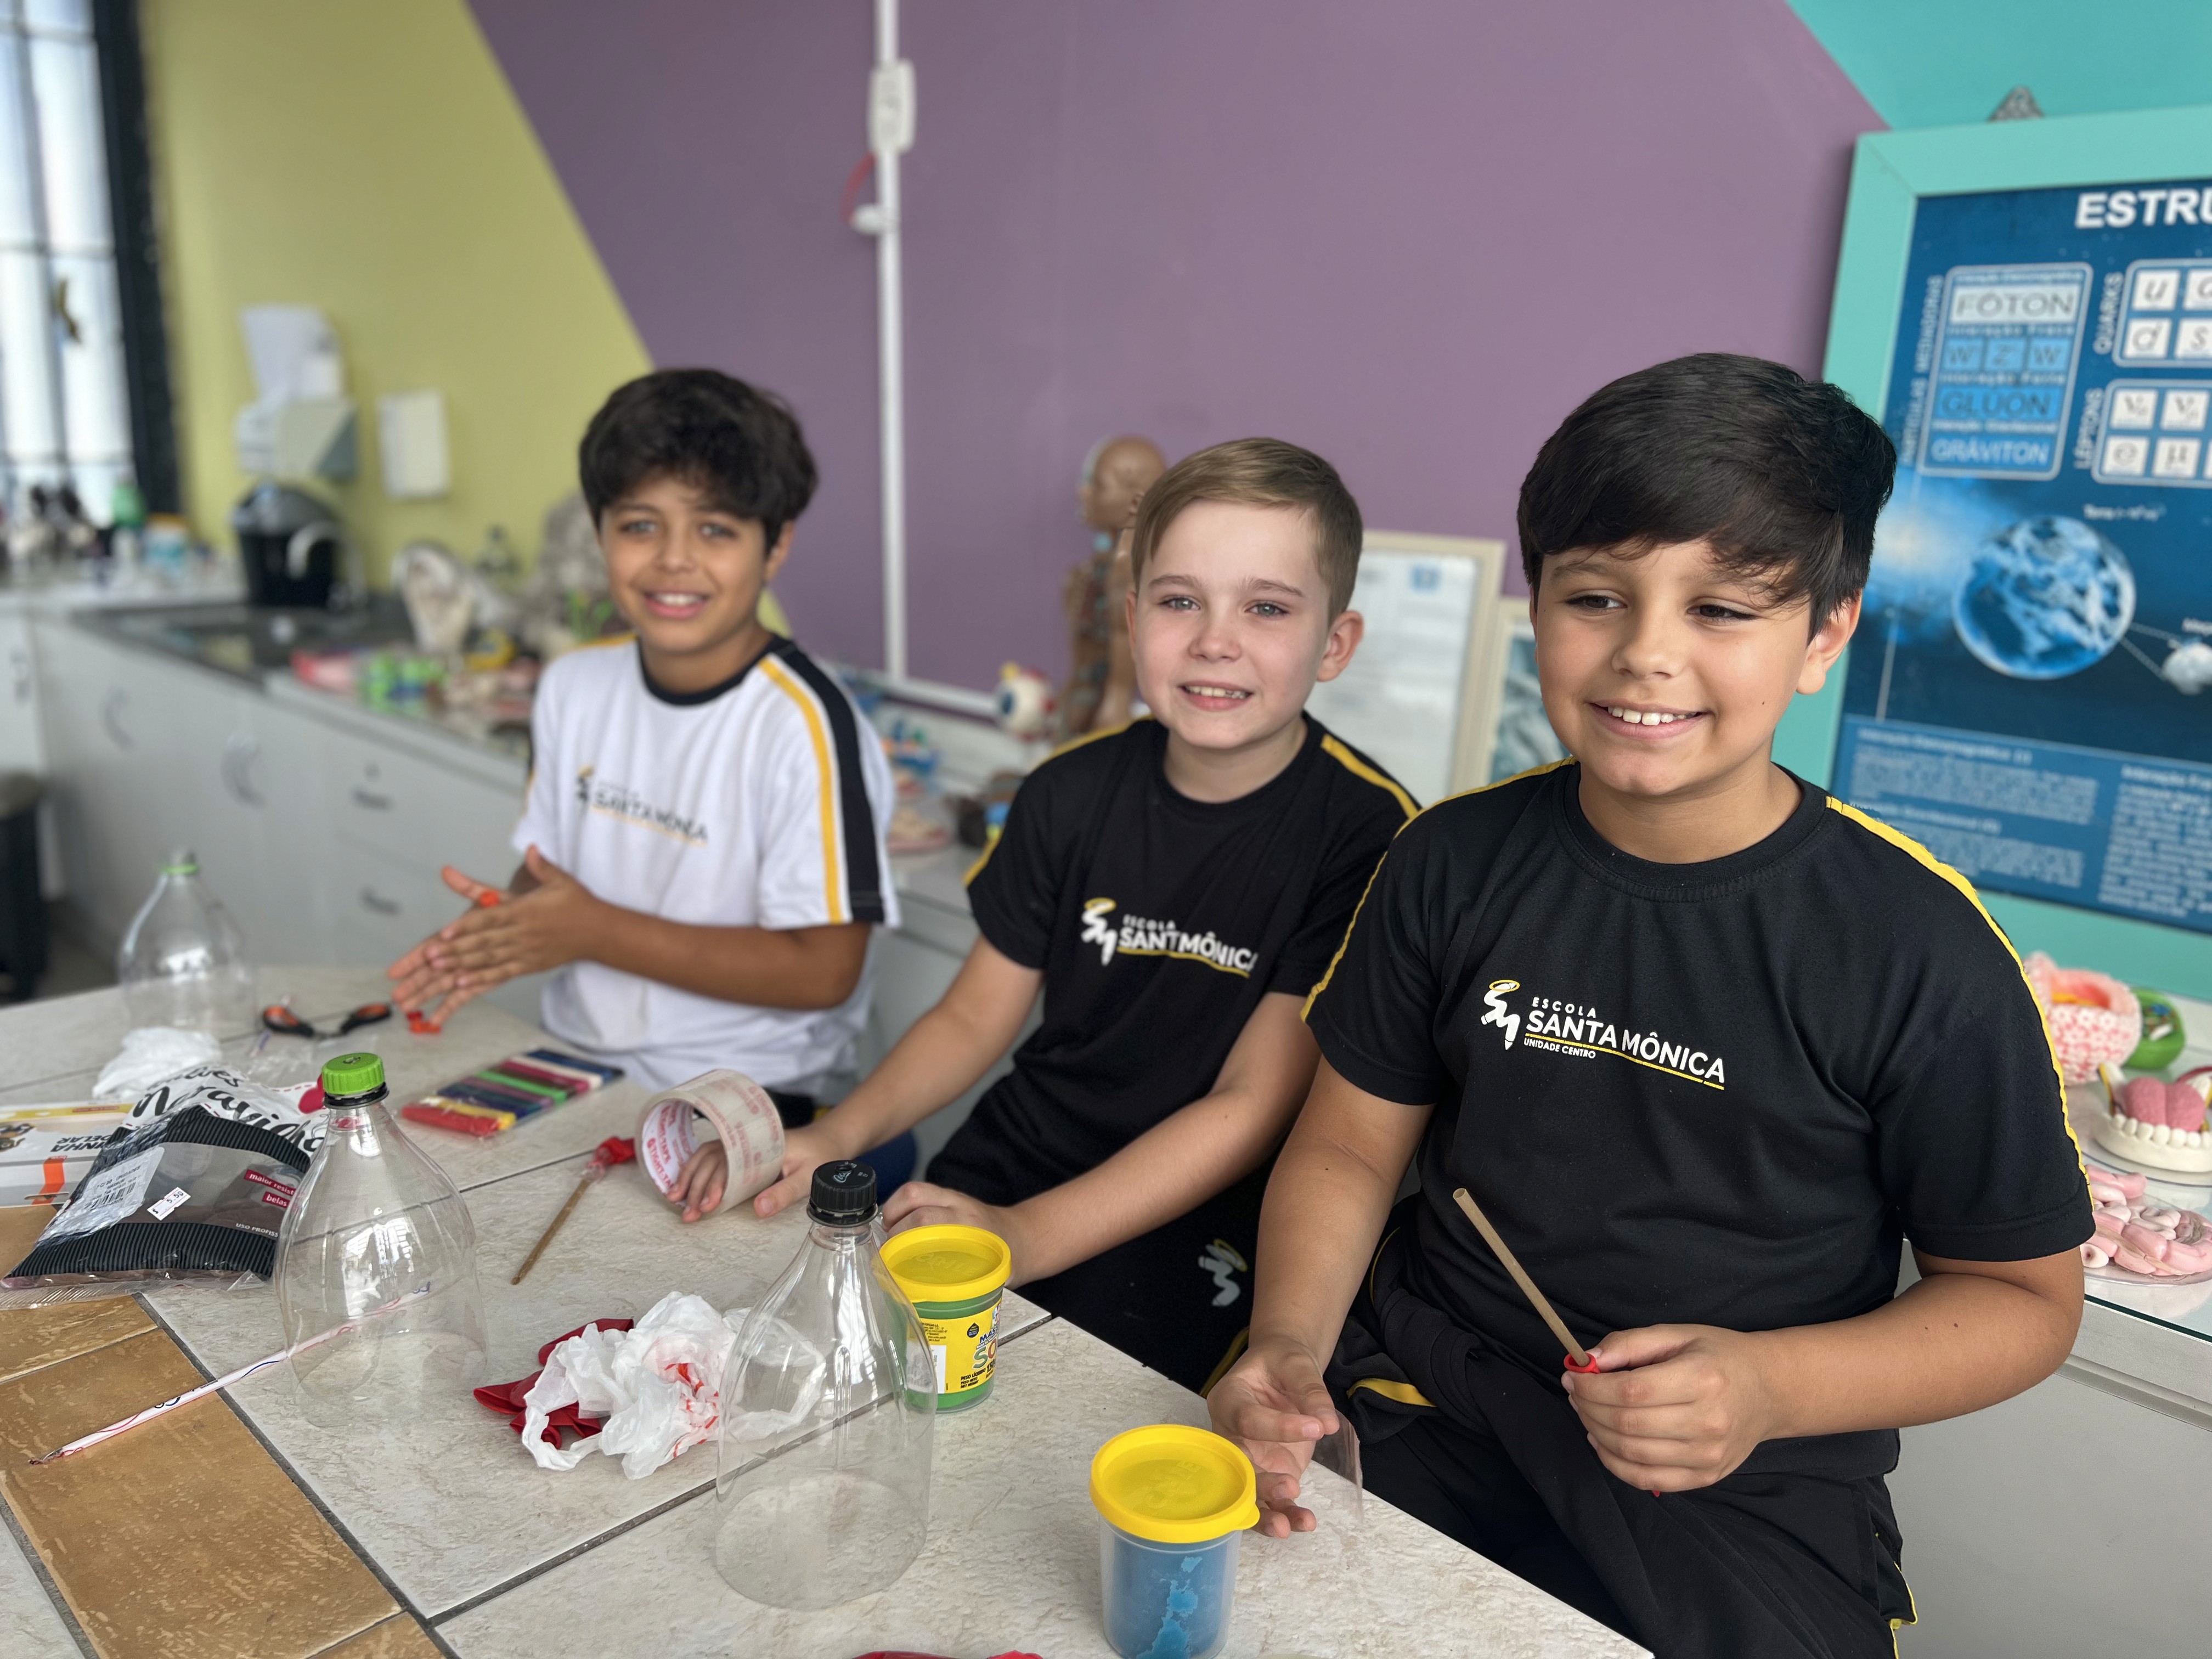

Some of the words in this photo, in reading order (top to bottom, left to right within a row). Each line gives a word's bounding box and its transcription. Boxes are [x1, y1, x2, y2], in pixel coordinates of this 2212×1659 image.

[2132, 320, 2163, 351] d
[1123, 915, 1176, 932] ESCOLA
[1119, 927, 1180, 951] SANT
[1532, 997, 1596, 1018] ESCOLA
[1523, 1038, 1560, 1052] UNIDADE
[1562, 1046, 1596, 1059] CENTRO
[1526, 1010, 1617, 1048] SANTA
[1622, 1030, 1725, 1084] MÔNICA
[650, 1144, 674, 1188] TIGHT-TA
[250, 1173, 272, 1186] maior
[266, 1193, 288, 1207] belas
[252, 1226, 279, 1238] PROFISS
